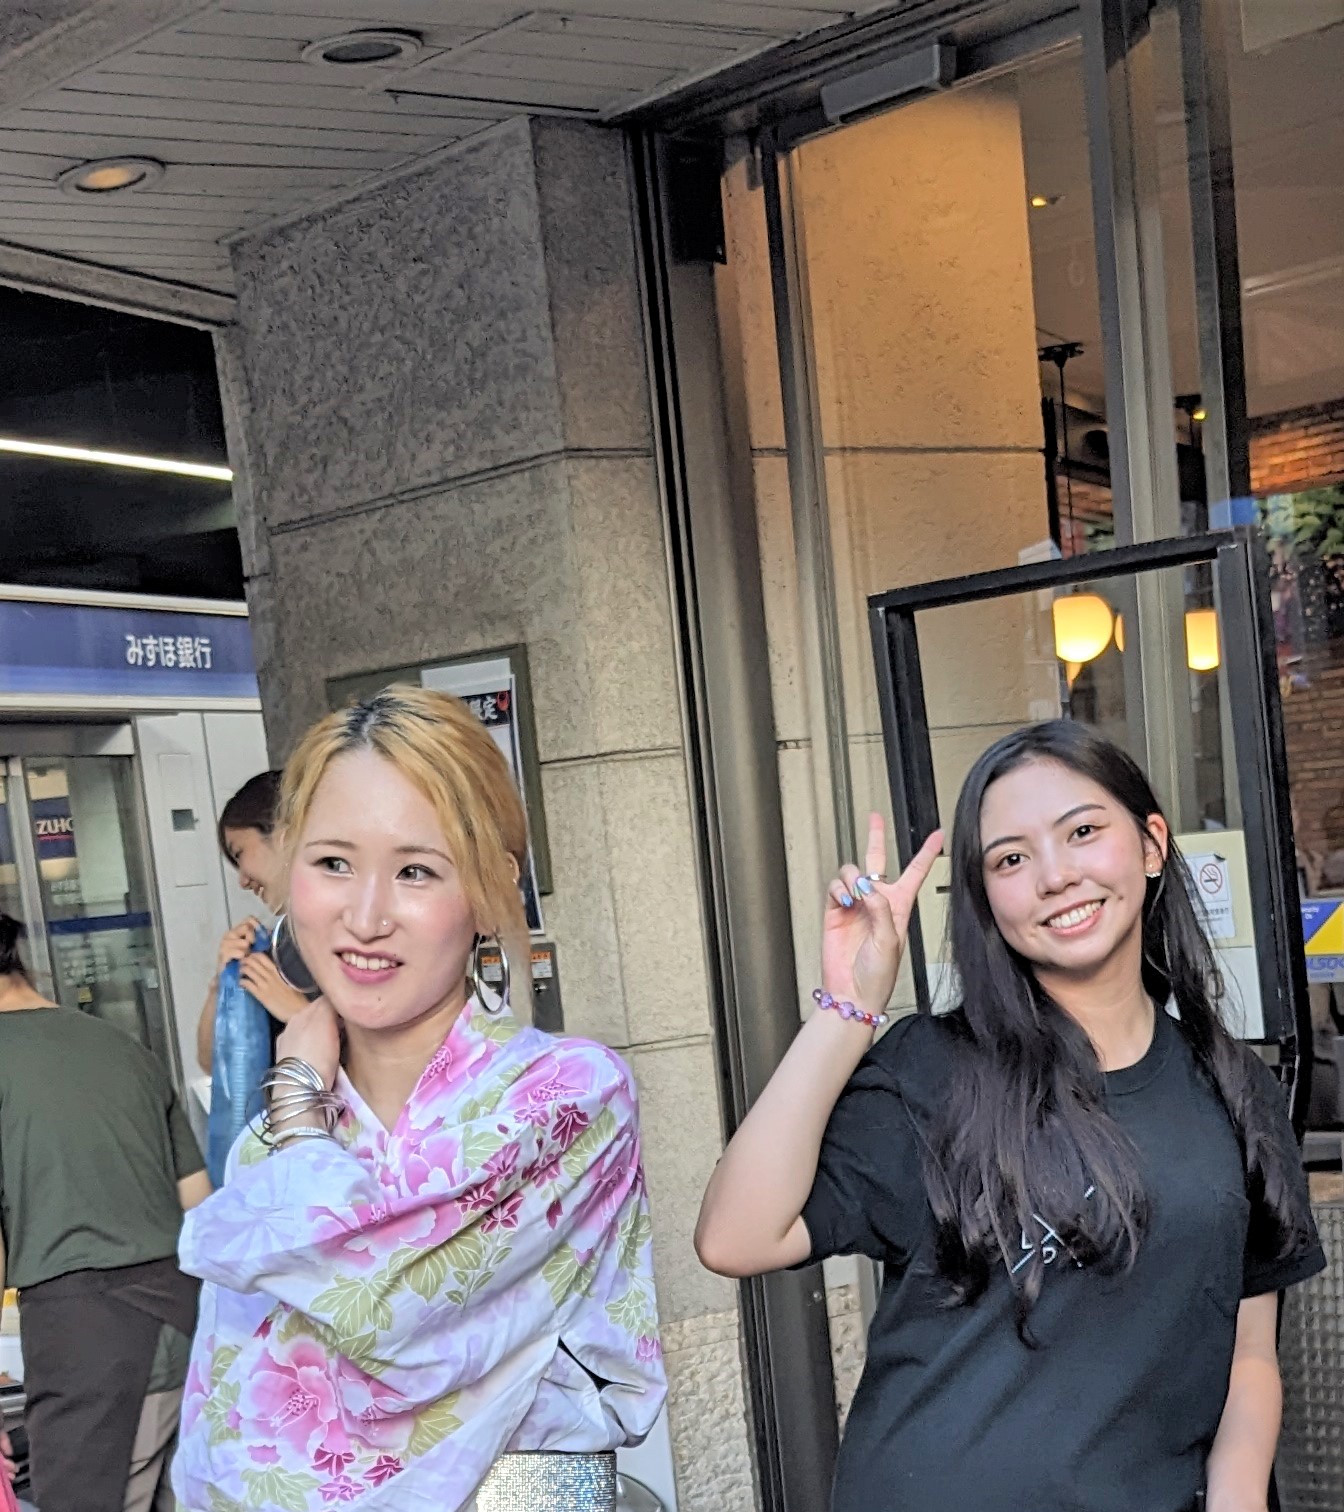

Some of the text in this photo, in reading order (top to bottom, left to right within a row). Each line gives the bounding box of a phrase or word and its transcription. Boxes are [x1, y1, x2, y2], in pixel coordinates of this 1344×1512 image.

[125, 635, 212, 669] みずほ銀行
